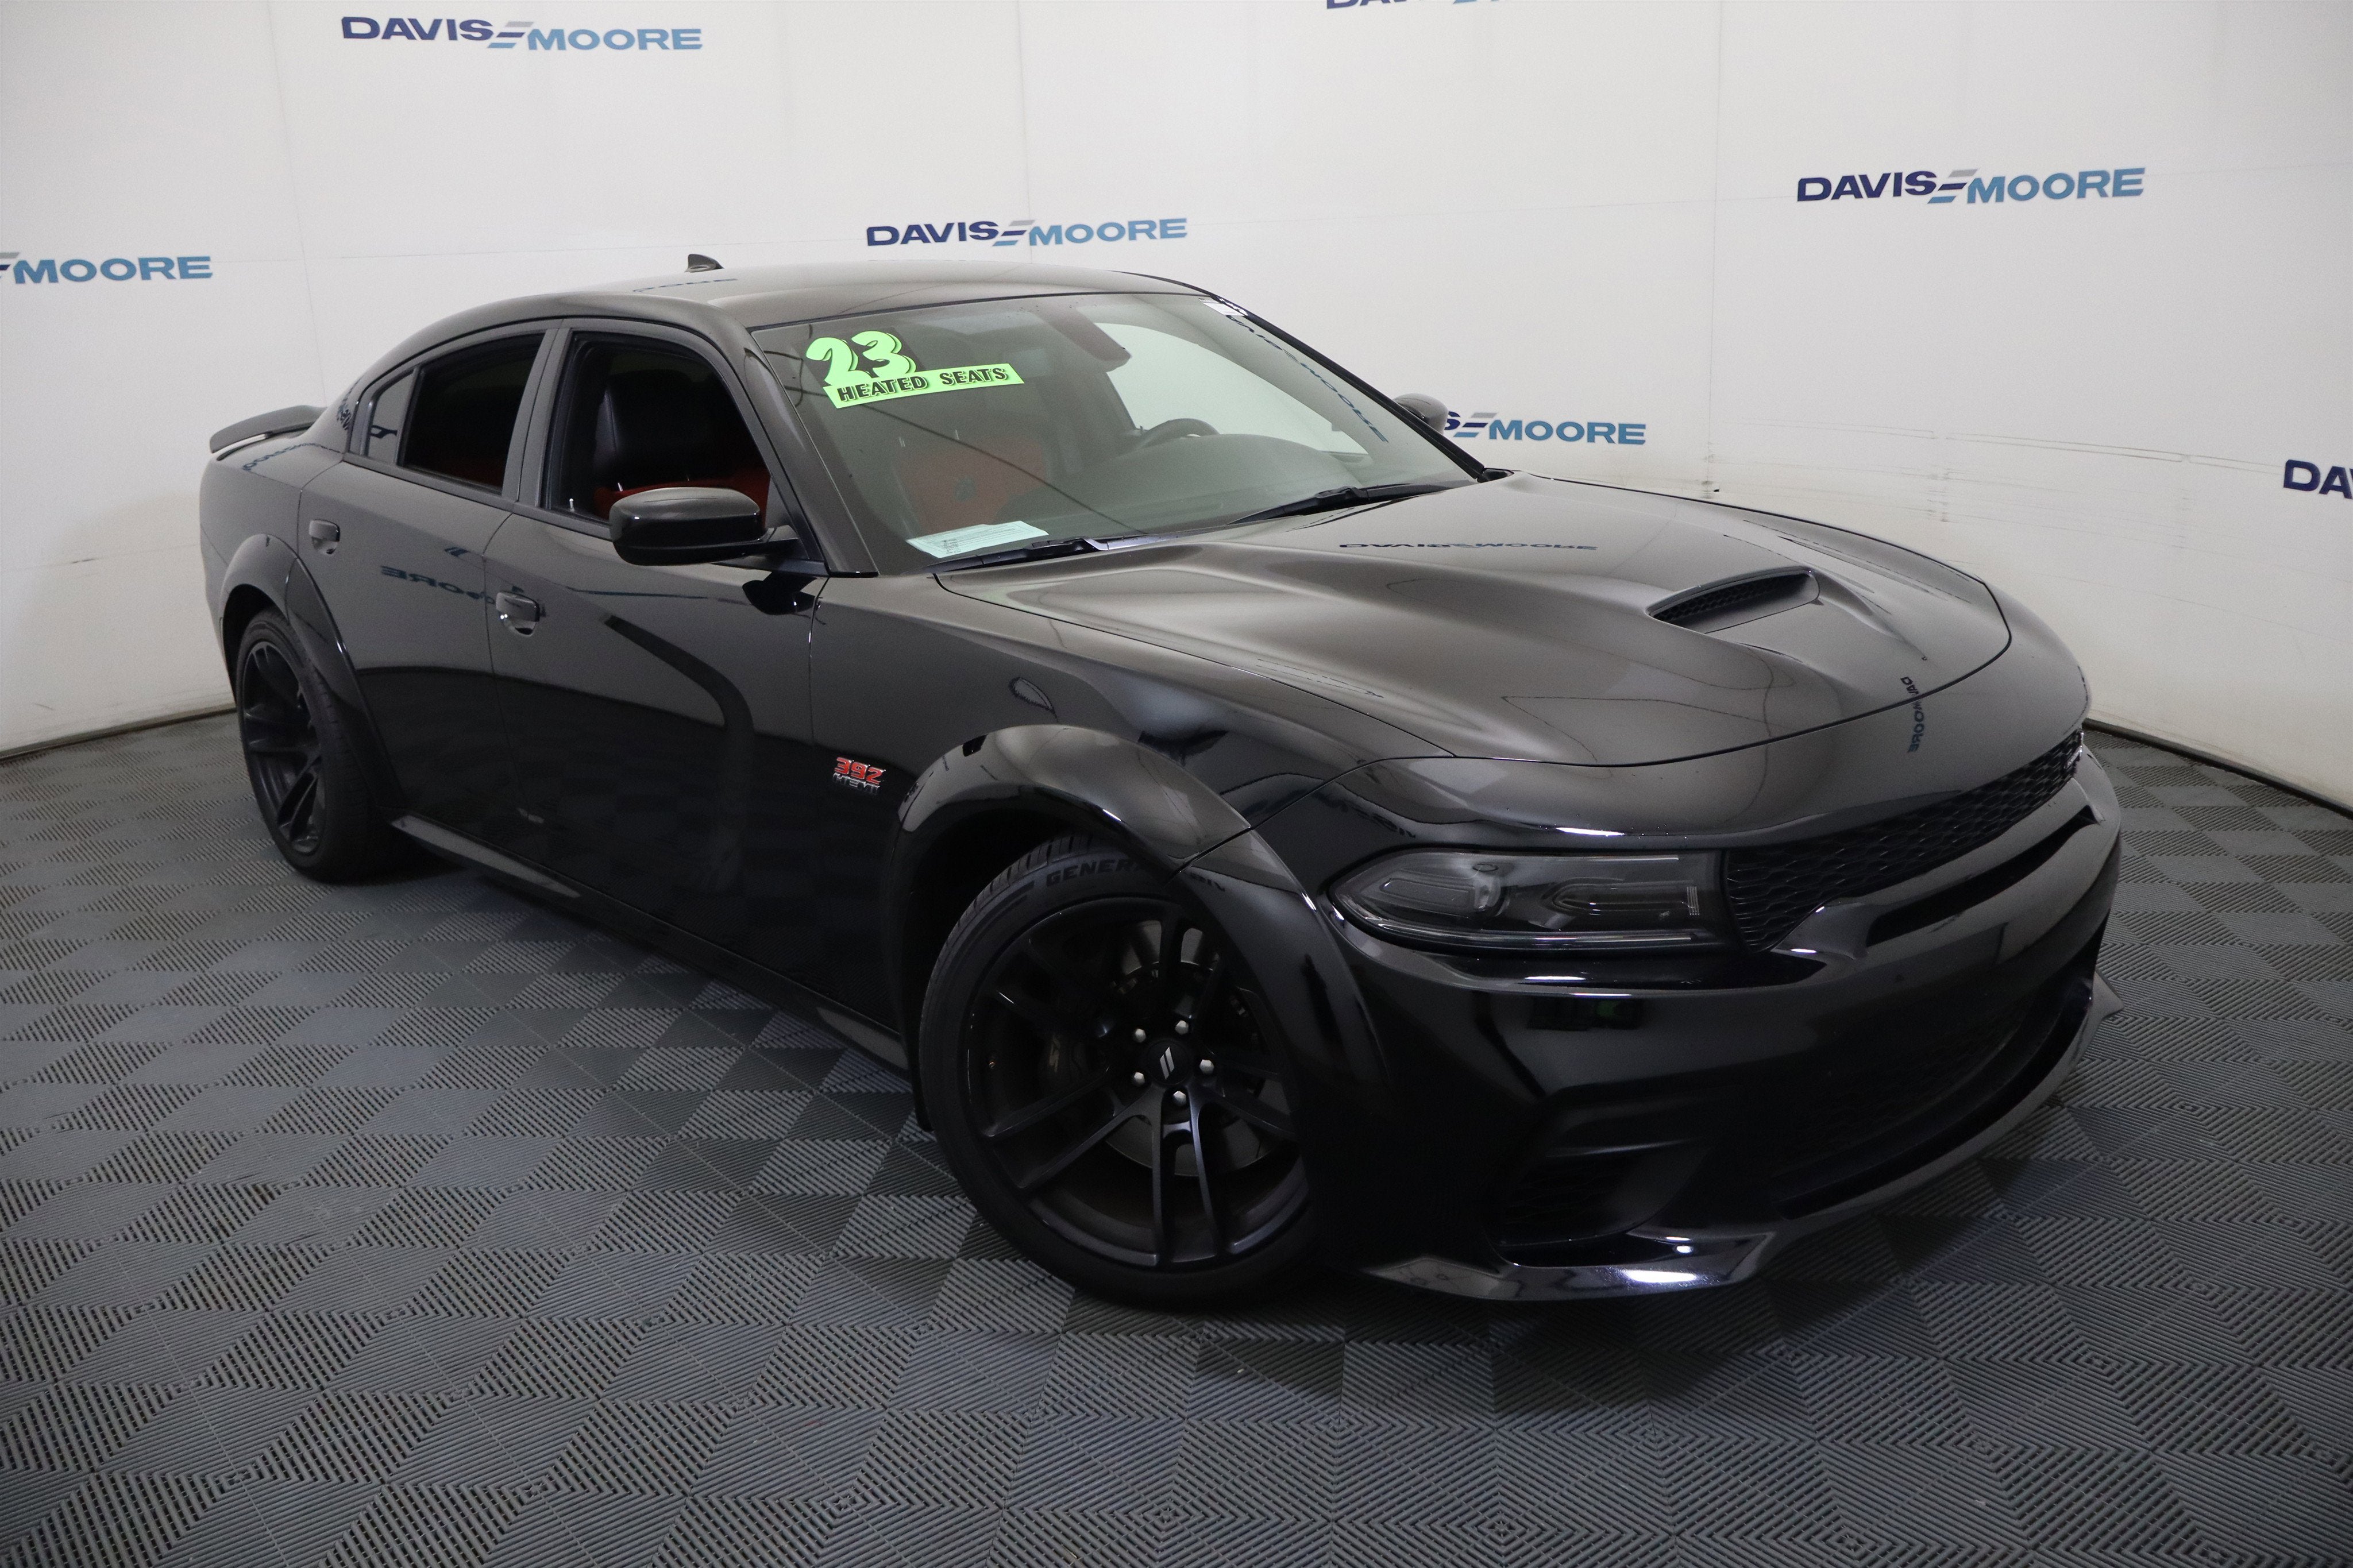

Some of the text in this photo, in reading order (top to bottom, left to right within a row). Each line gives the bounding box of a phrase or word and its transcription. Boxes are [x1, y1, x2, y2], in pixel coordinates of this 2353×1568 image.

[341, 16, 703, 51] DAVIS MOORE
[1797, 167, 2146, 204] DAVIS MOORE
[866, 218, 1187, 246] DAVIS MOORE
[13, 256, 213, 284] MOORE
[805, 330, 917, 385] 23
[836, 368, 1009, 402] HEATED SEATS
[1488, 419, 1646, 445] MOORE
[2283, 459, 2353, 500] DA
[834, 757, 886, 785] 392
